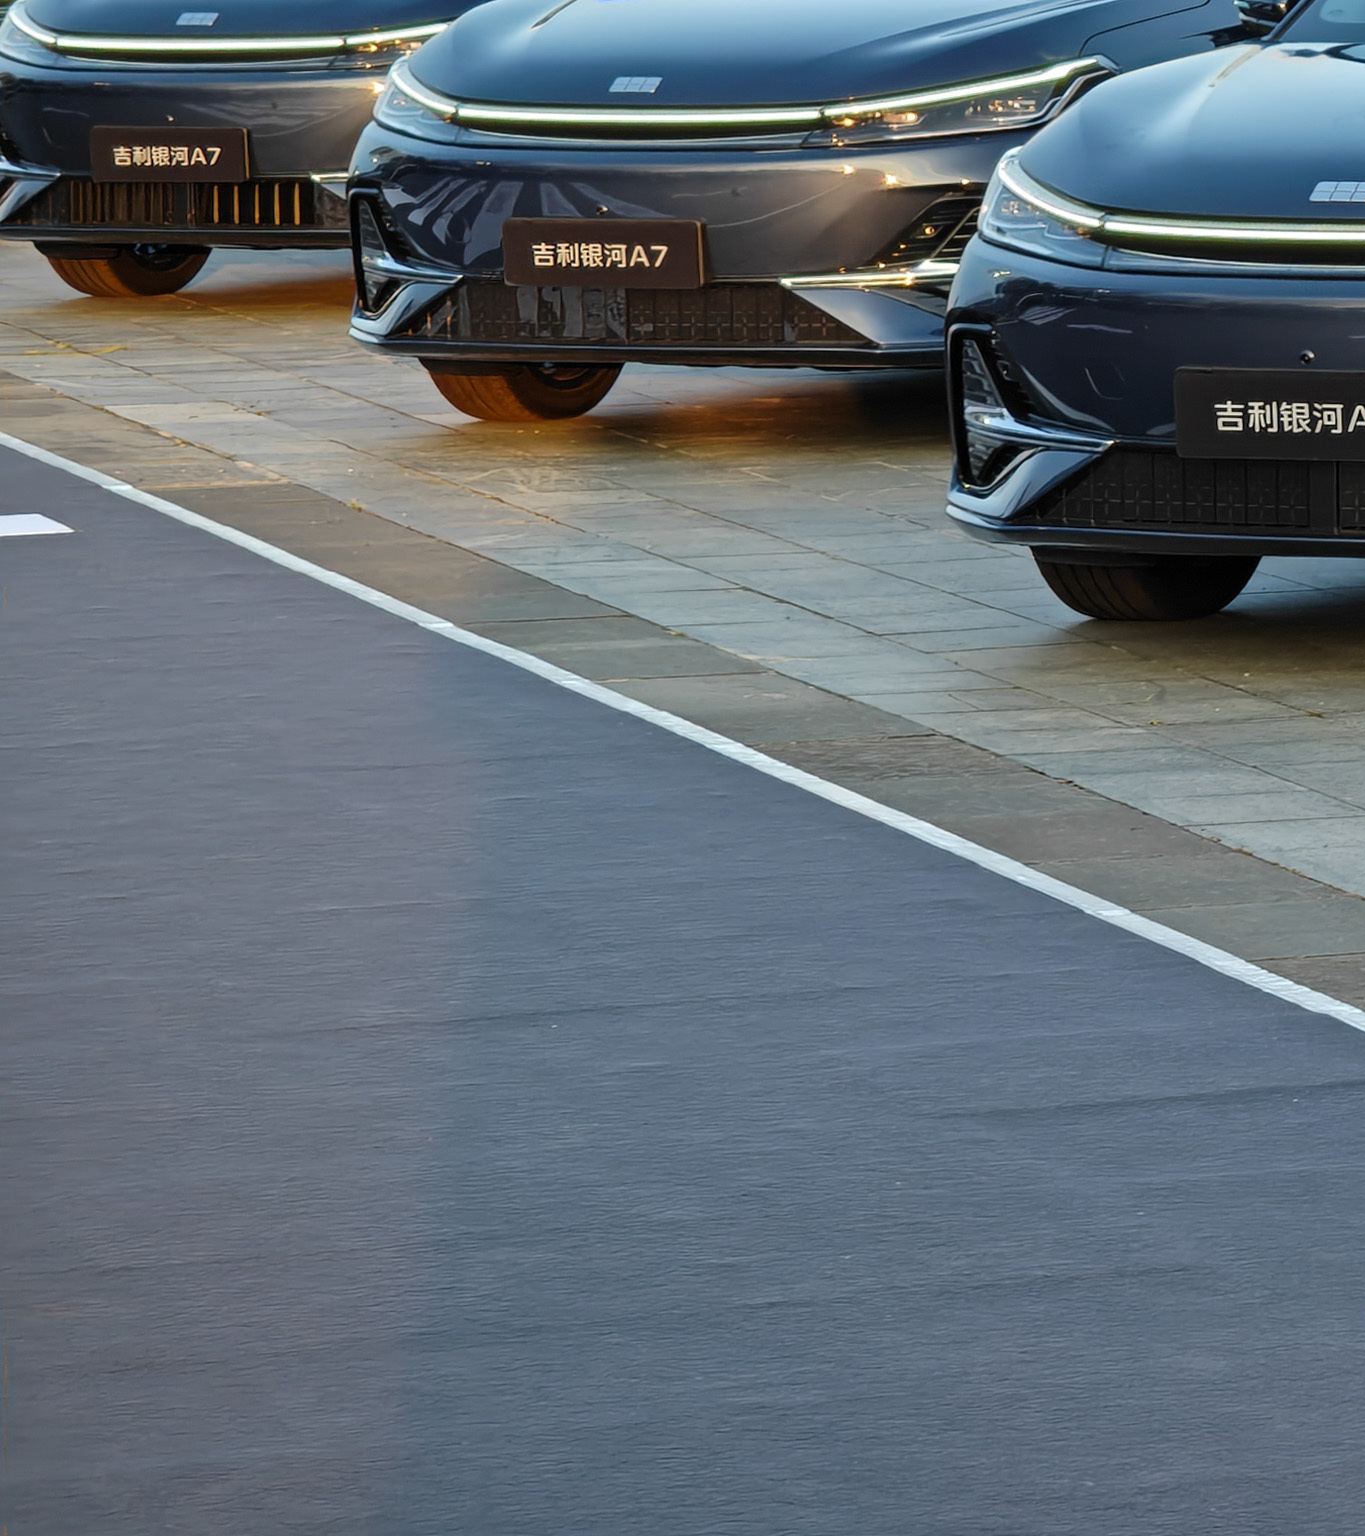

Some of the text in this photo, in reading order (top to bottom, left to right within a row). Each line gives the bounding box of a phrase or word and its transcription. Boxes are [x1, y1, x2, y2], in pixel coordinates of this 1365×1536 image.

[112, 145, 222, 167] 吉利银河A7
[531, 242, 669, 268] 吉利银河A7
